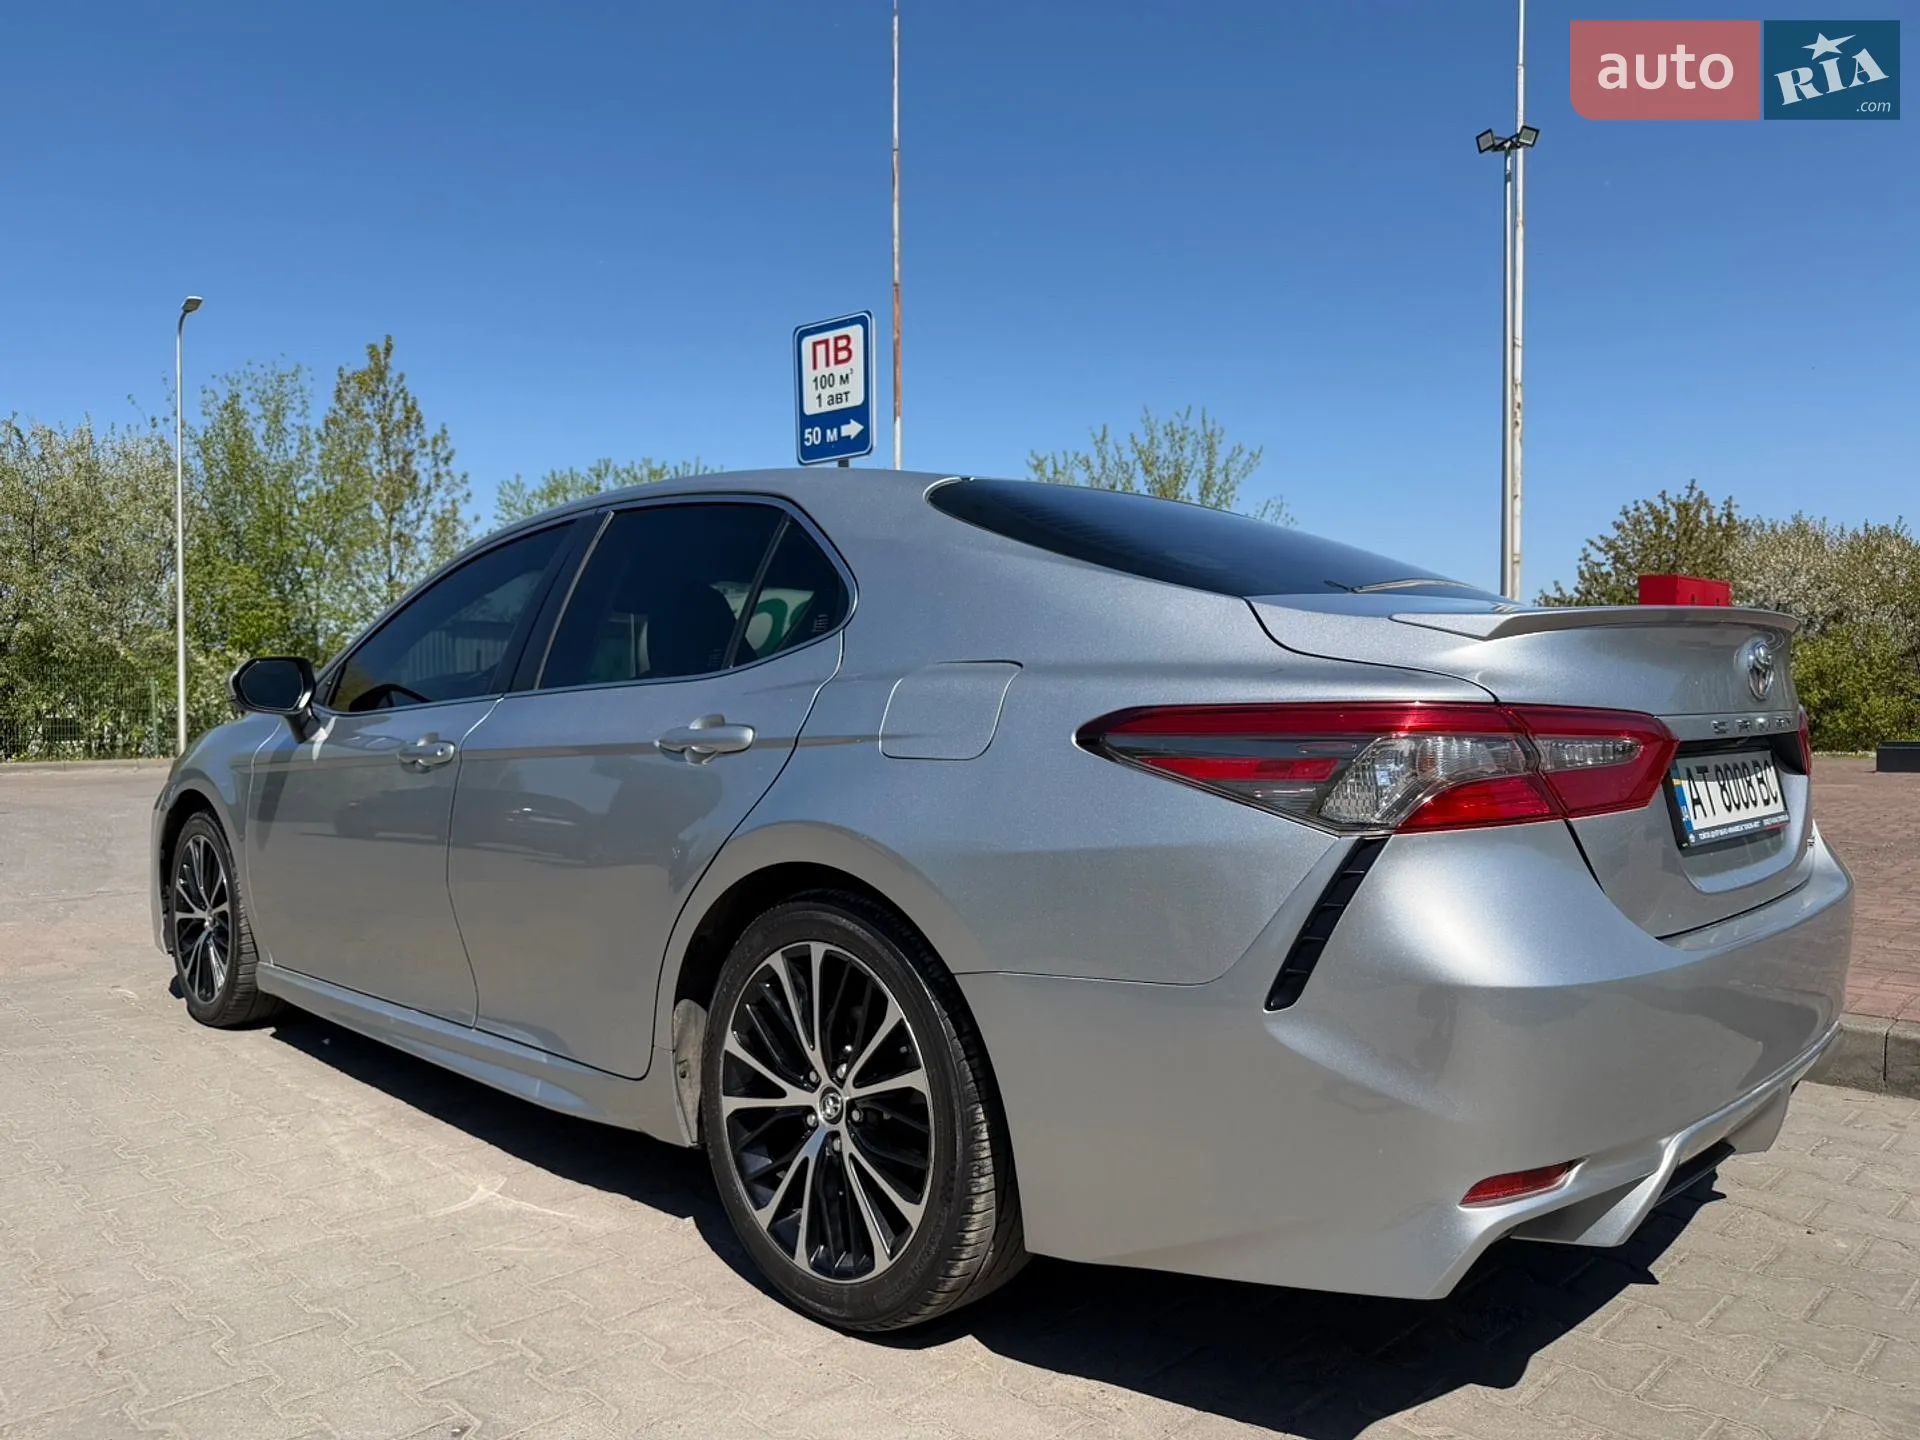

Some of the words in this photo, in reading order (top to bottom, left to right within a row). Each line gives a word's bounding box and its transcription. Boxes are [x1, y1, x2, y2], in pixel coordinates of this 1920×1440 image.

[811, 334, 853, 370] ПВ
[812, 372, 835, 391] 100
[816, 393, 822, 407] 1
[827, 391, 850, 407] авт
[804, 427, 821, 446] 50
[826, 428, 838, 443] м
[1685, 765, 1716, 820] AT
[1714, 760, 1758, 814] 8008
